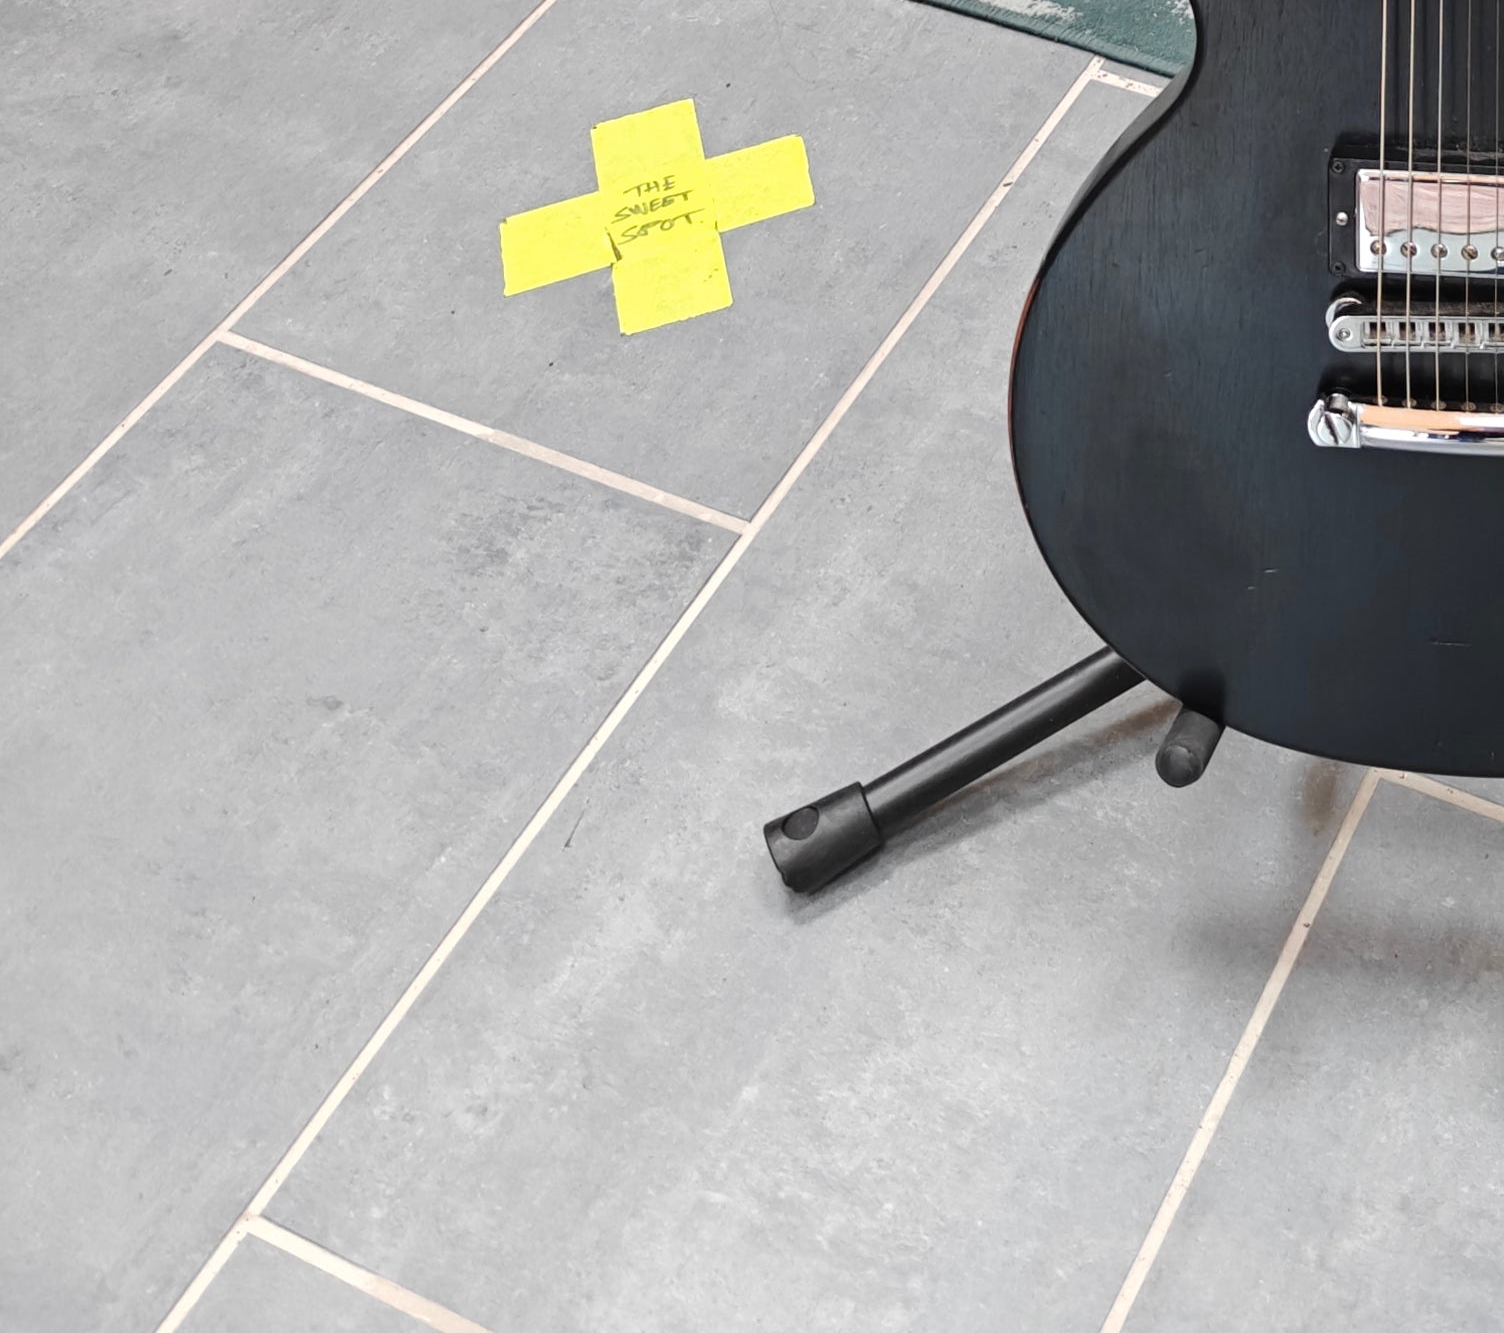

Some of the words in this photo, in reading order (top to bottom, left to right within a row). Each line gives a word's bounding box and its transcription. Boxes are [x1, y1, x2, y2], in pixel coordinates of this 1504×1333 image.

[623, 175, 676, 197] THE
[611, 189, 694, 224] SWEET
[617, 208, 706, 245] SPOT
